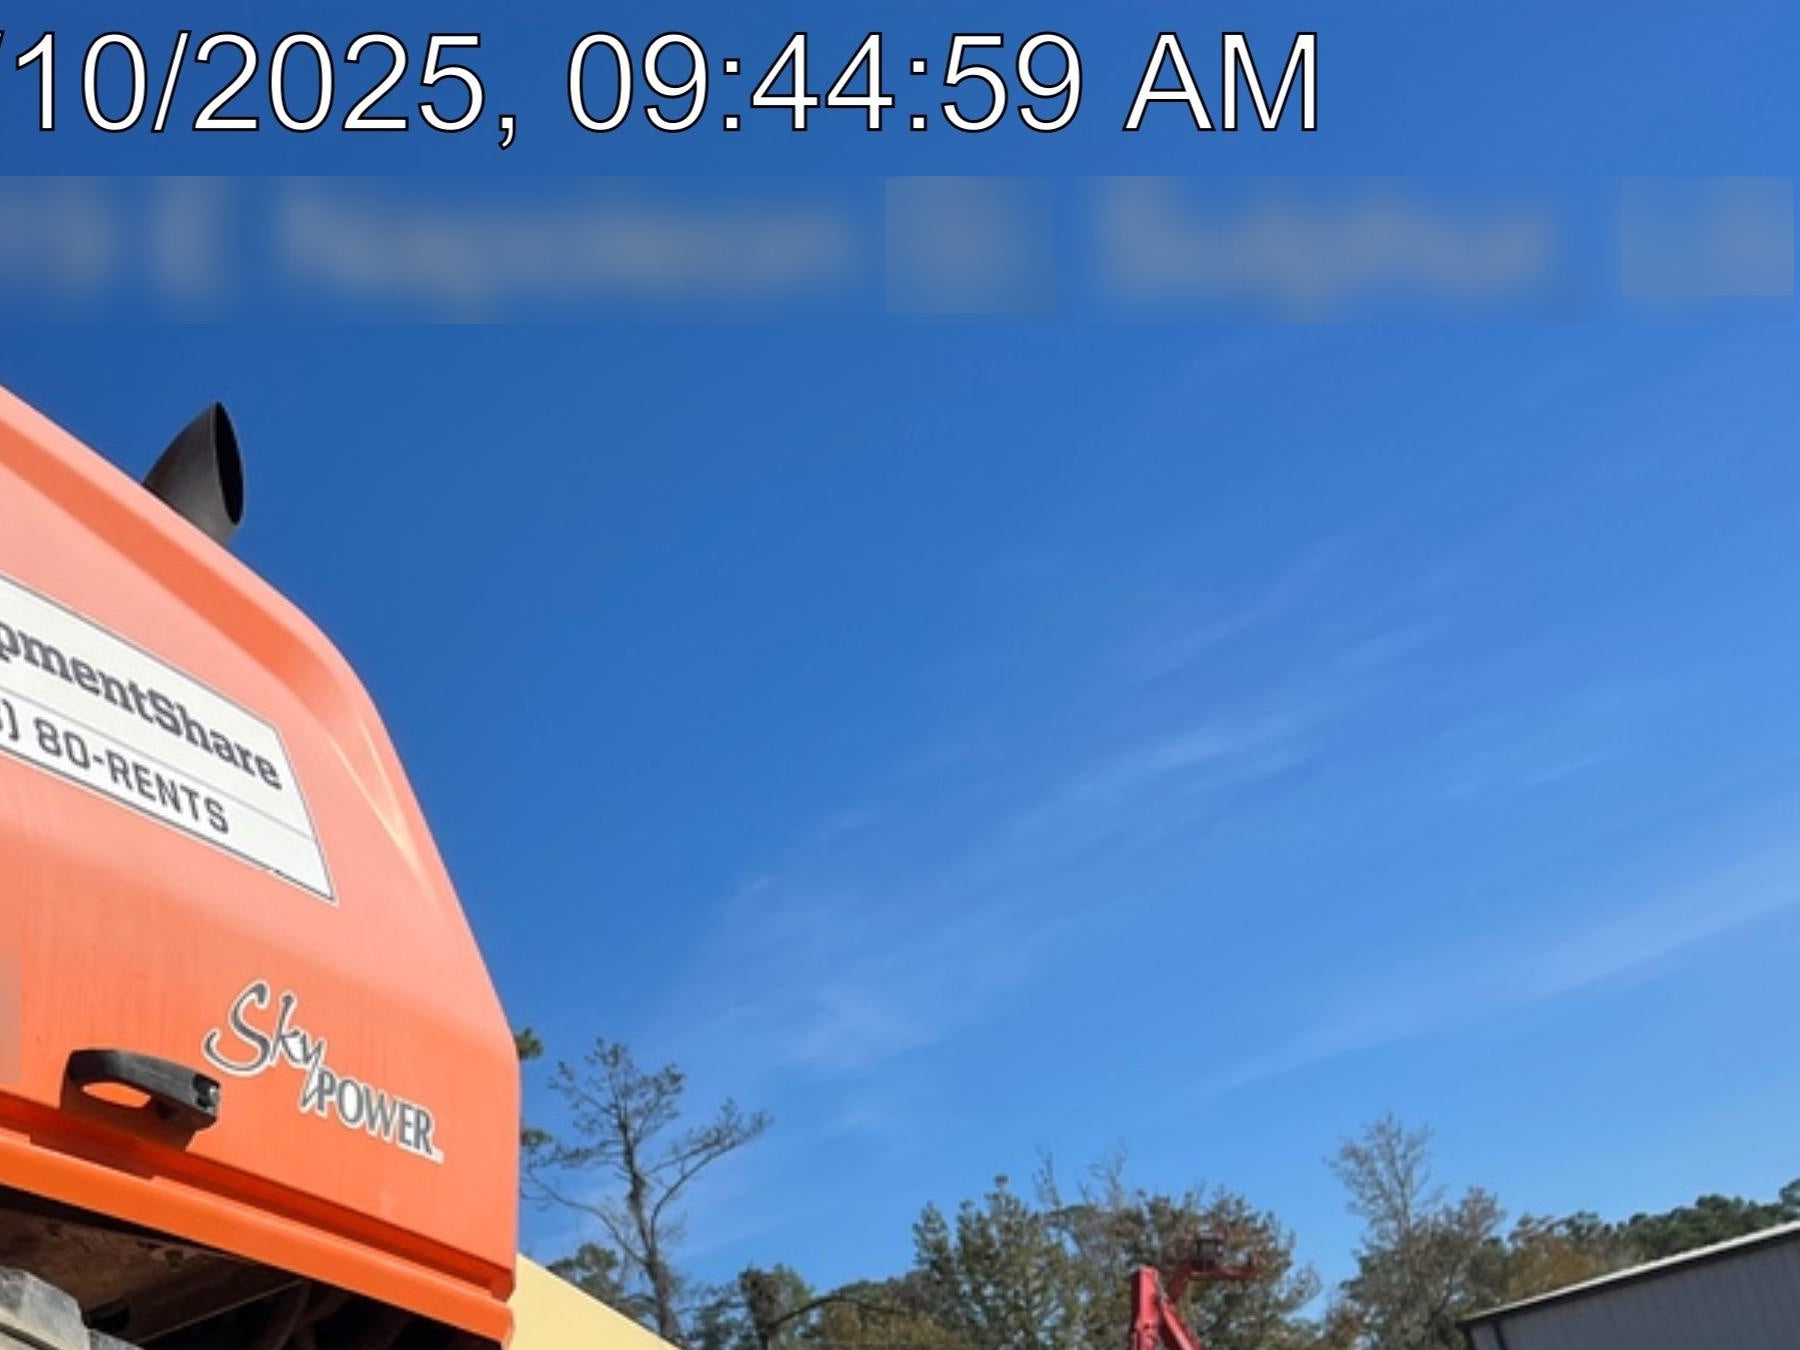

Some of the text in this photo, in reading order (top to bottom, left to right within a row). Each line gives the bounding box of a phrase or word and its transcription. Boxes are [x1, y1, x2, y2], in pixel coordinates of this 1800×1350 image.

[34, 718, 230, 834] 80-RENTS
[203, 981, 324, 1109] Sky
[316, 1066, 436, 1155] POWER
